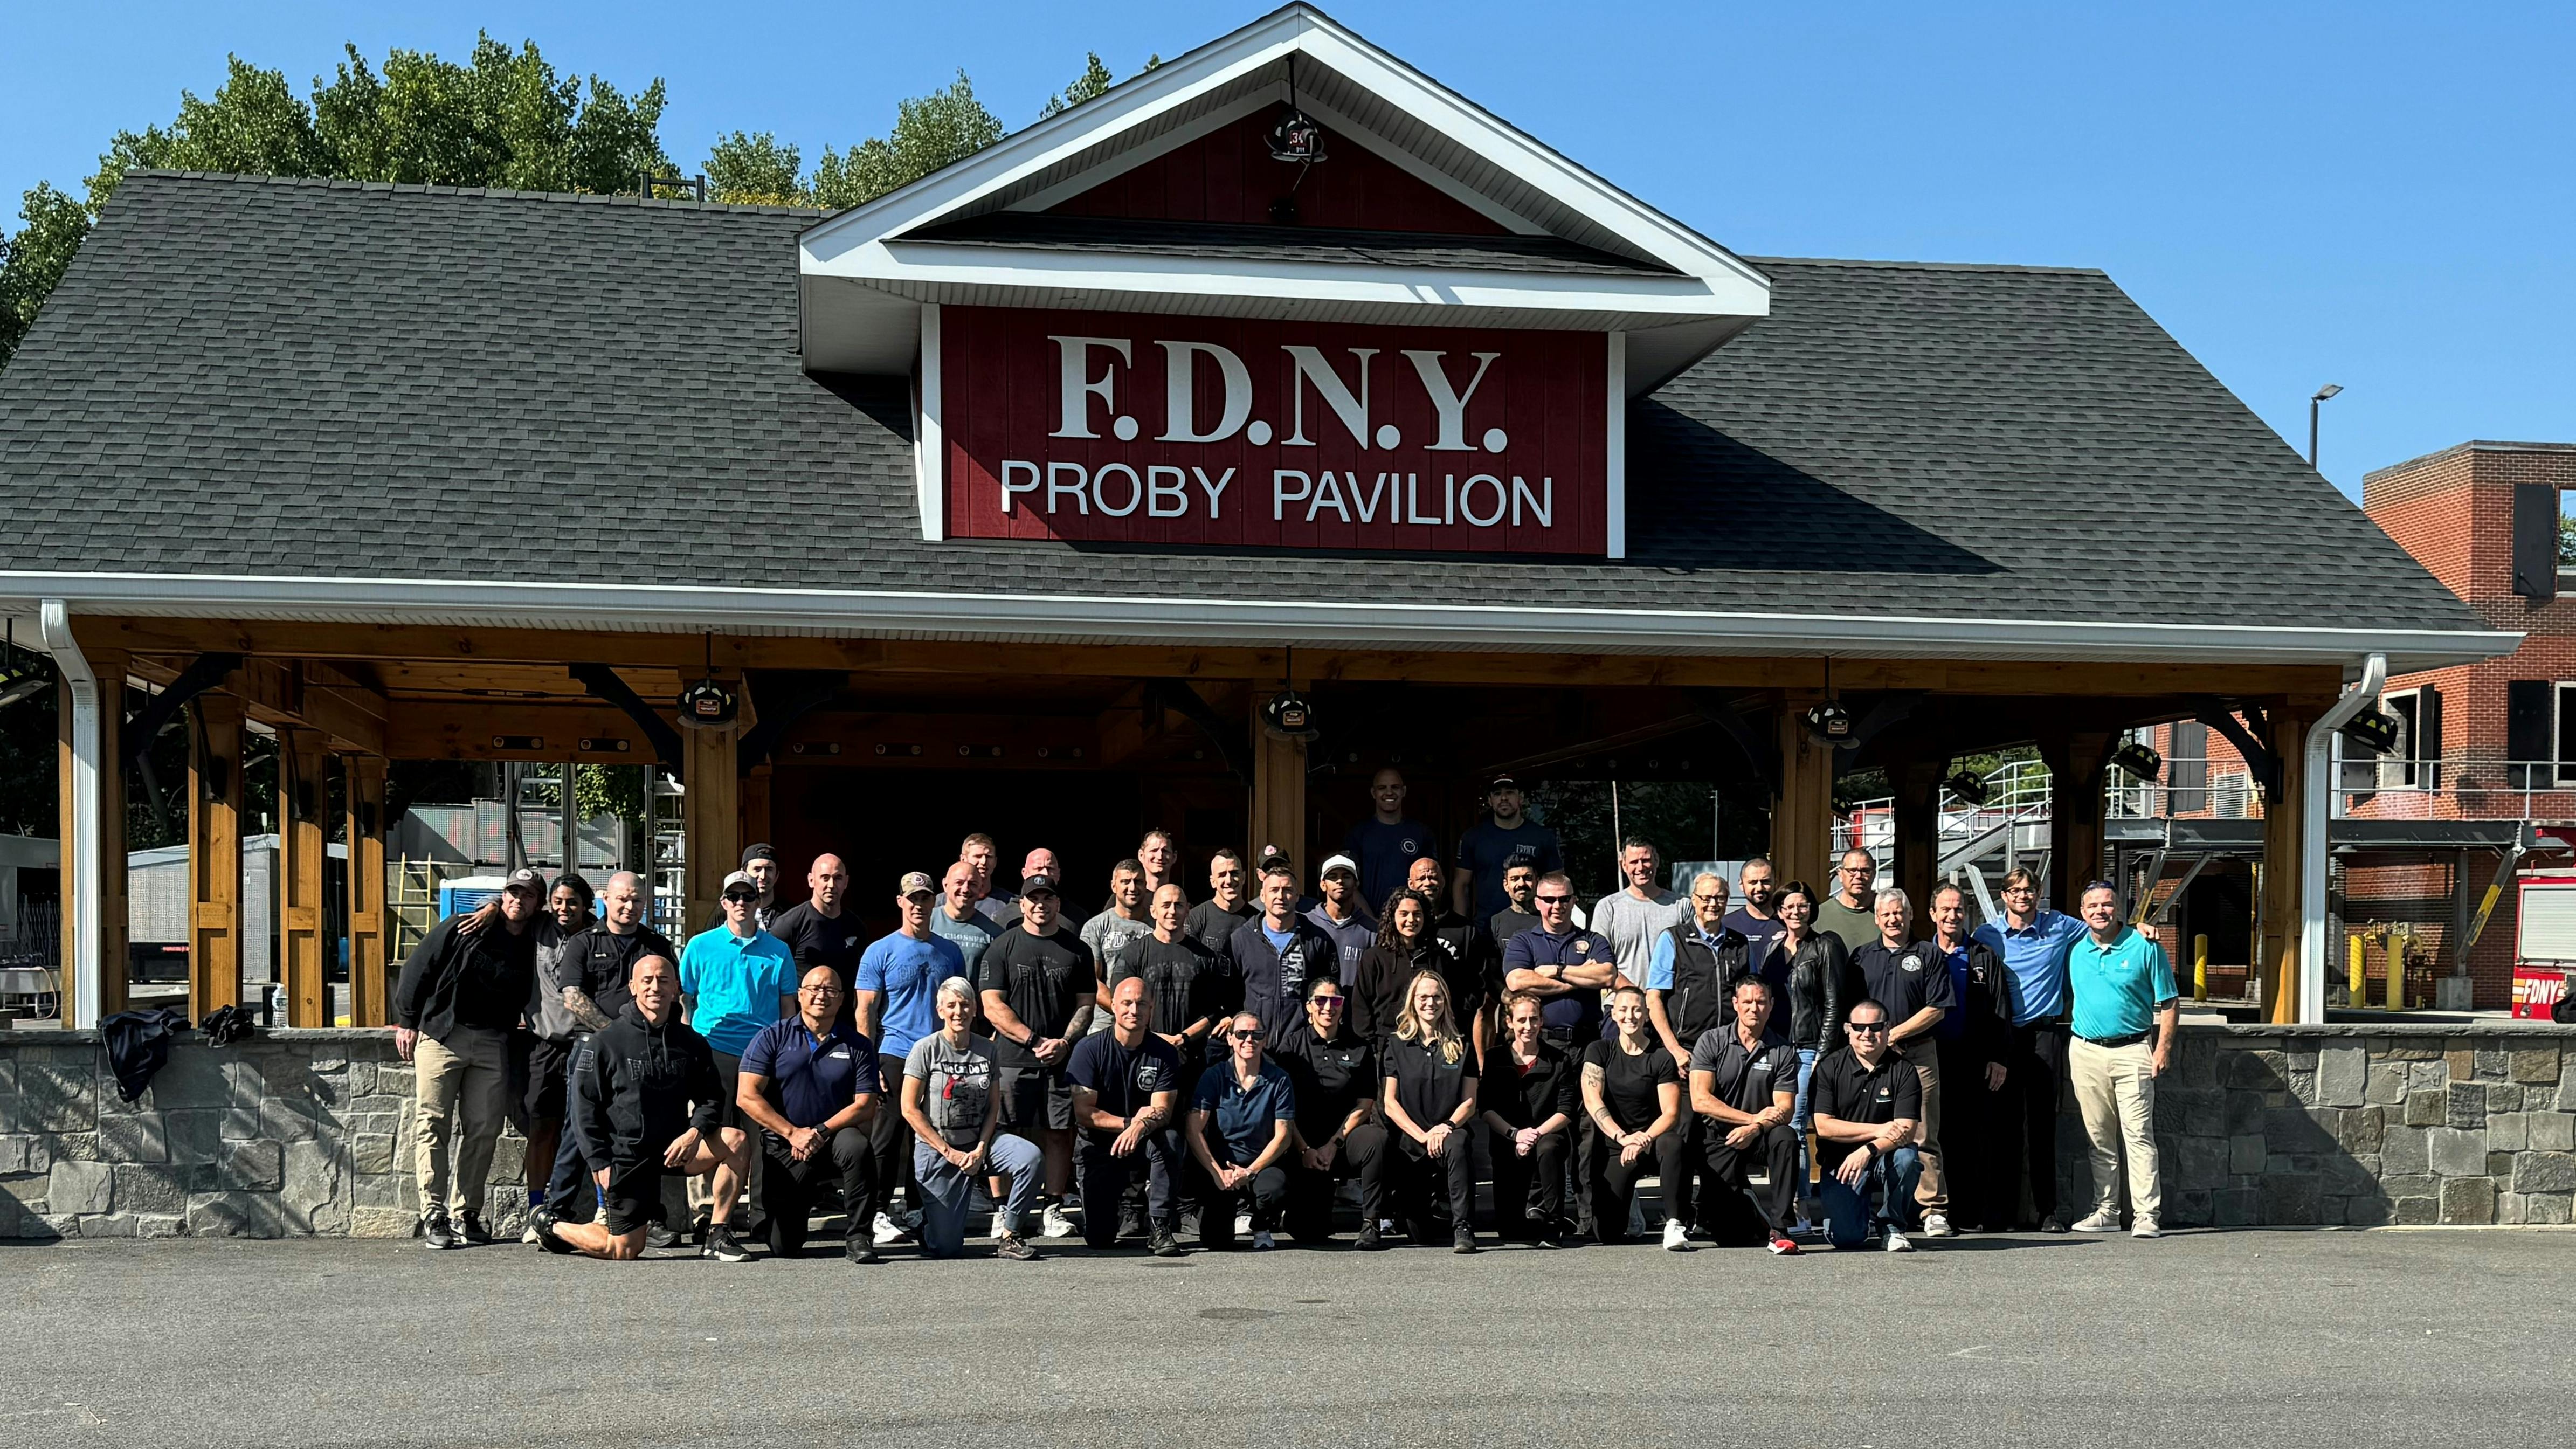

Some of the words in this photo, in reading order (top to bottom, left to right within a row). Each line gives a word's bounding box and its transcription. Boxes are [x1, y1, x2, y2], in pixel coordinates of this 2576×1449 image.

[1047, 335, 1508, 453] F.D.N.Y.
[1002, 460, 1236, 519] PROBY
[1274, 470, 1552, 527] PAVILION
[2523, 979, 2561, 1005] FDNY
[968, 1064, 980, 1074] Do
